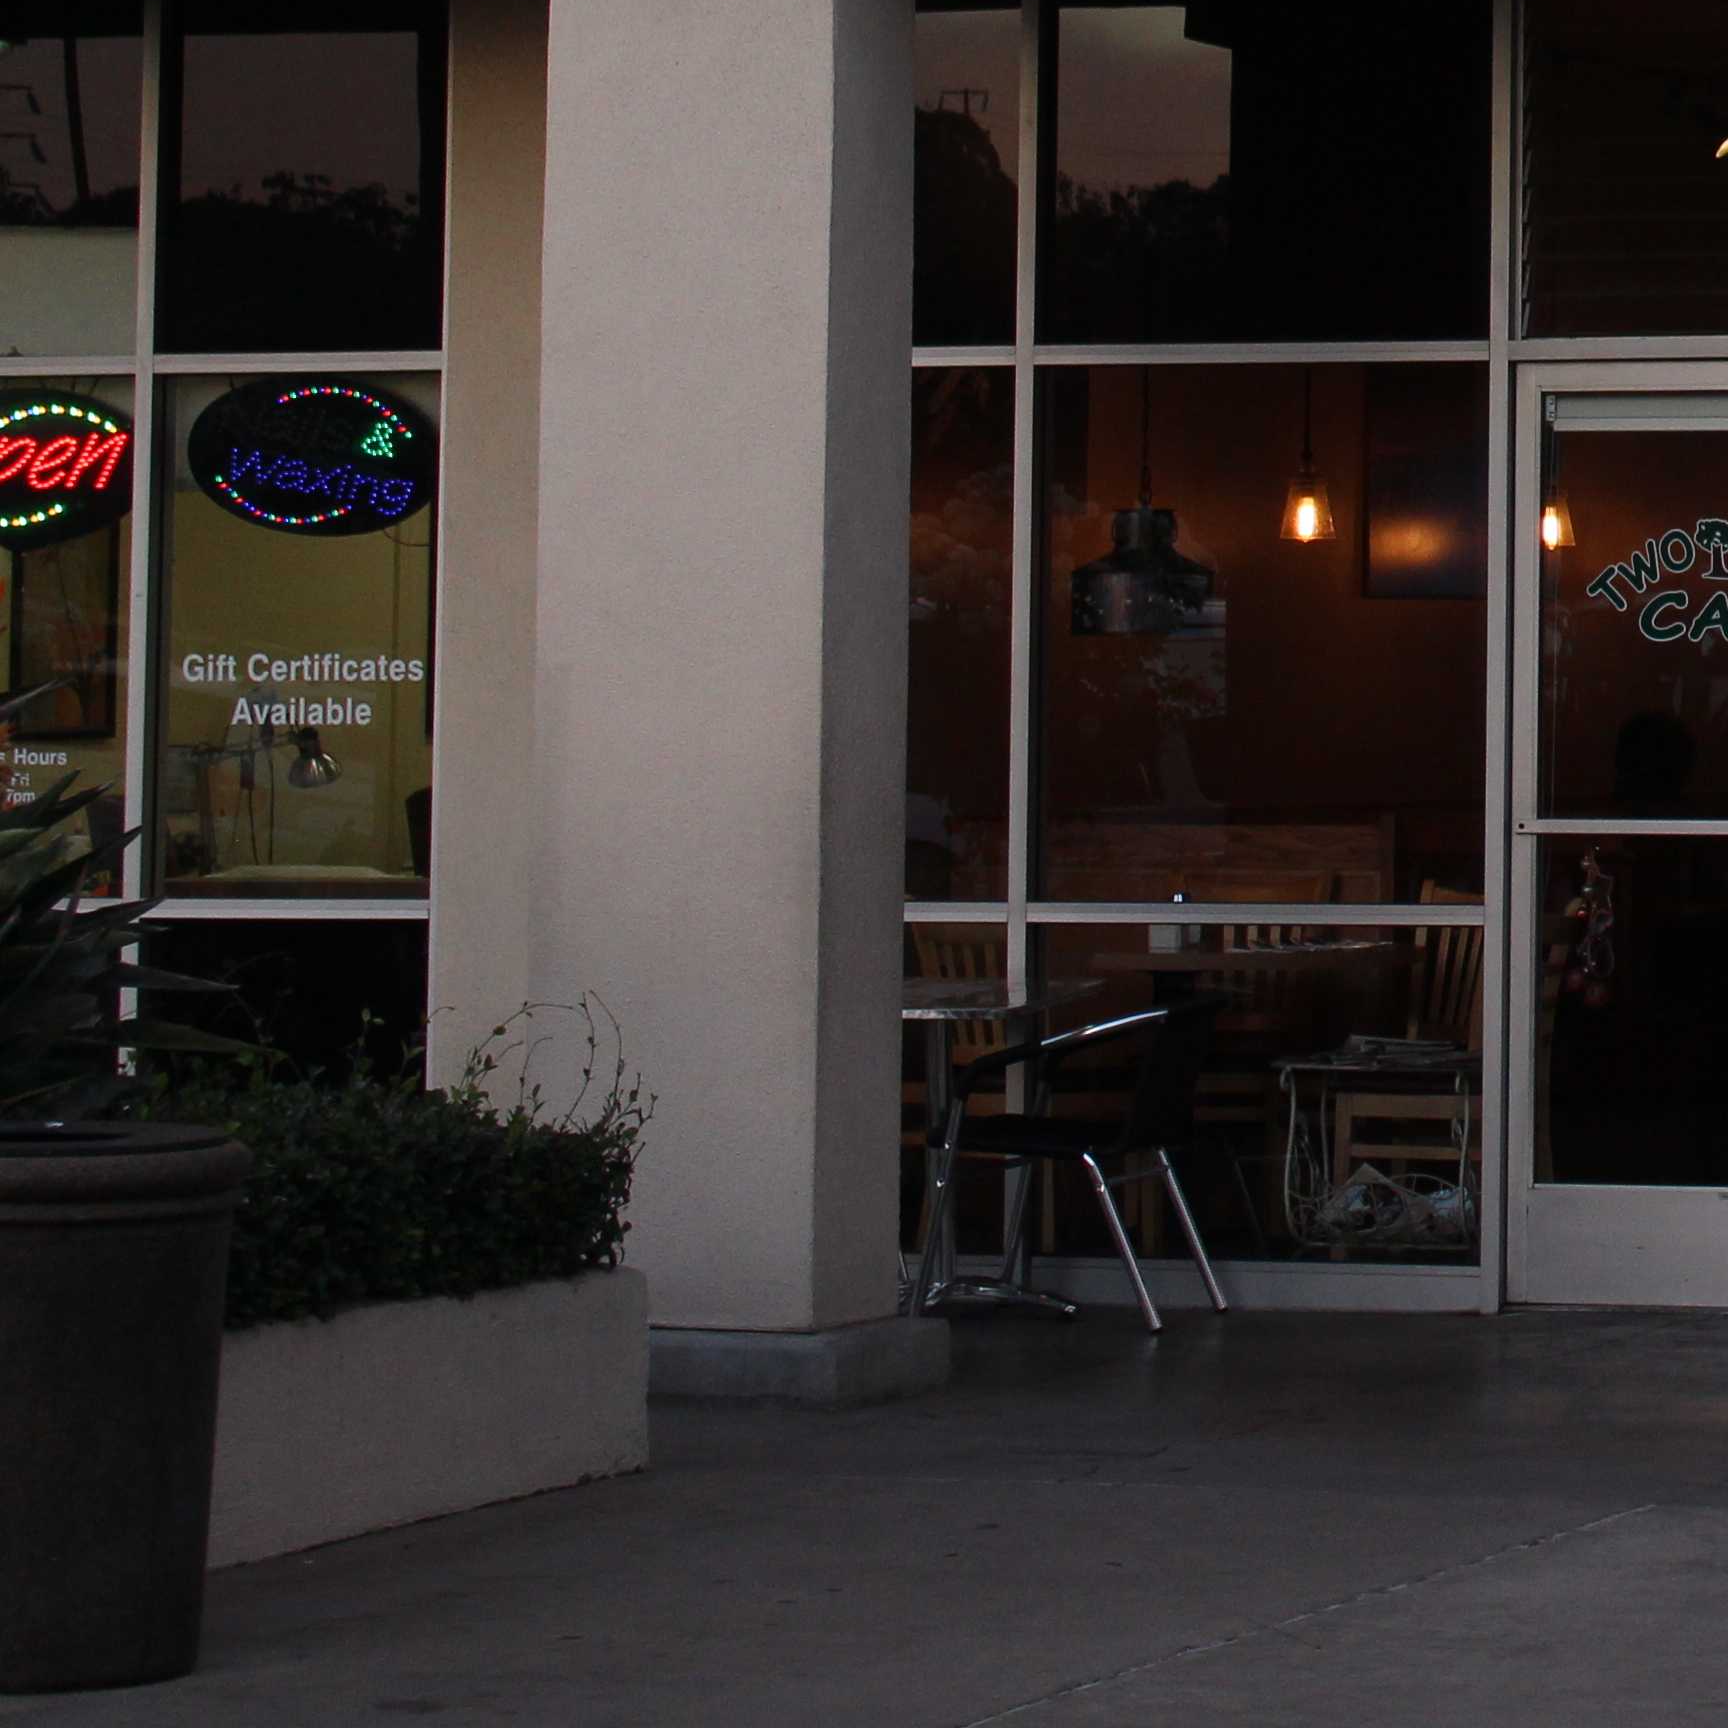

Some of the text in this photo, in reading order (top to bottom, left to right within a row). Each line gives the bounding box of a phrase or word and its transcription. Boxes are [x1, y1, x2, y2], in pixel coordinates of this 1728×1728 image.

[361, 422, 394, 458] &
[0, 432, 129, 489] pen
[1586, 528, 1696, 612] TWO
[181, 653, 425, 683] Gift Certificates
[231, 697, 373, 726] Available
[13, 748, 68, 766] Hours
